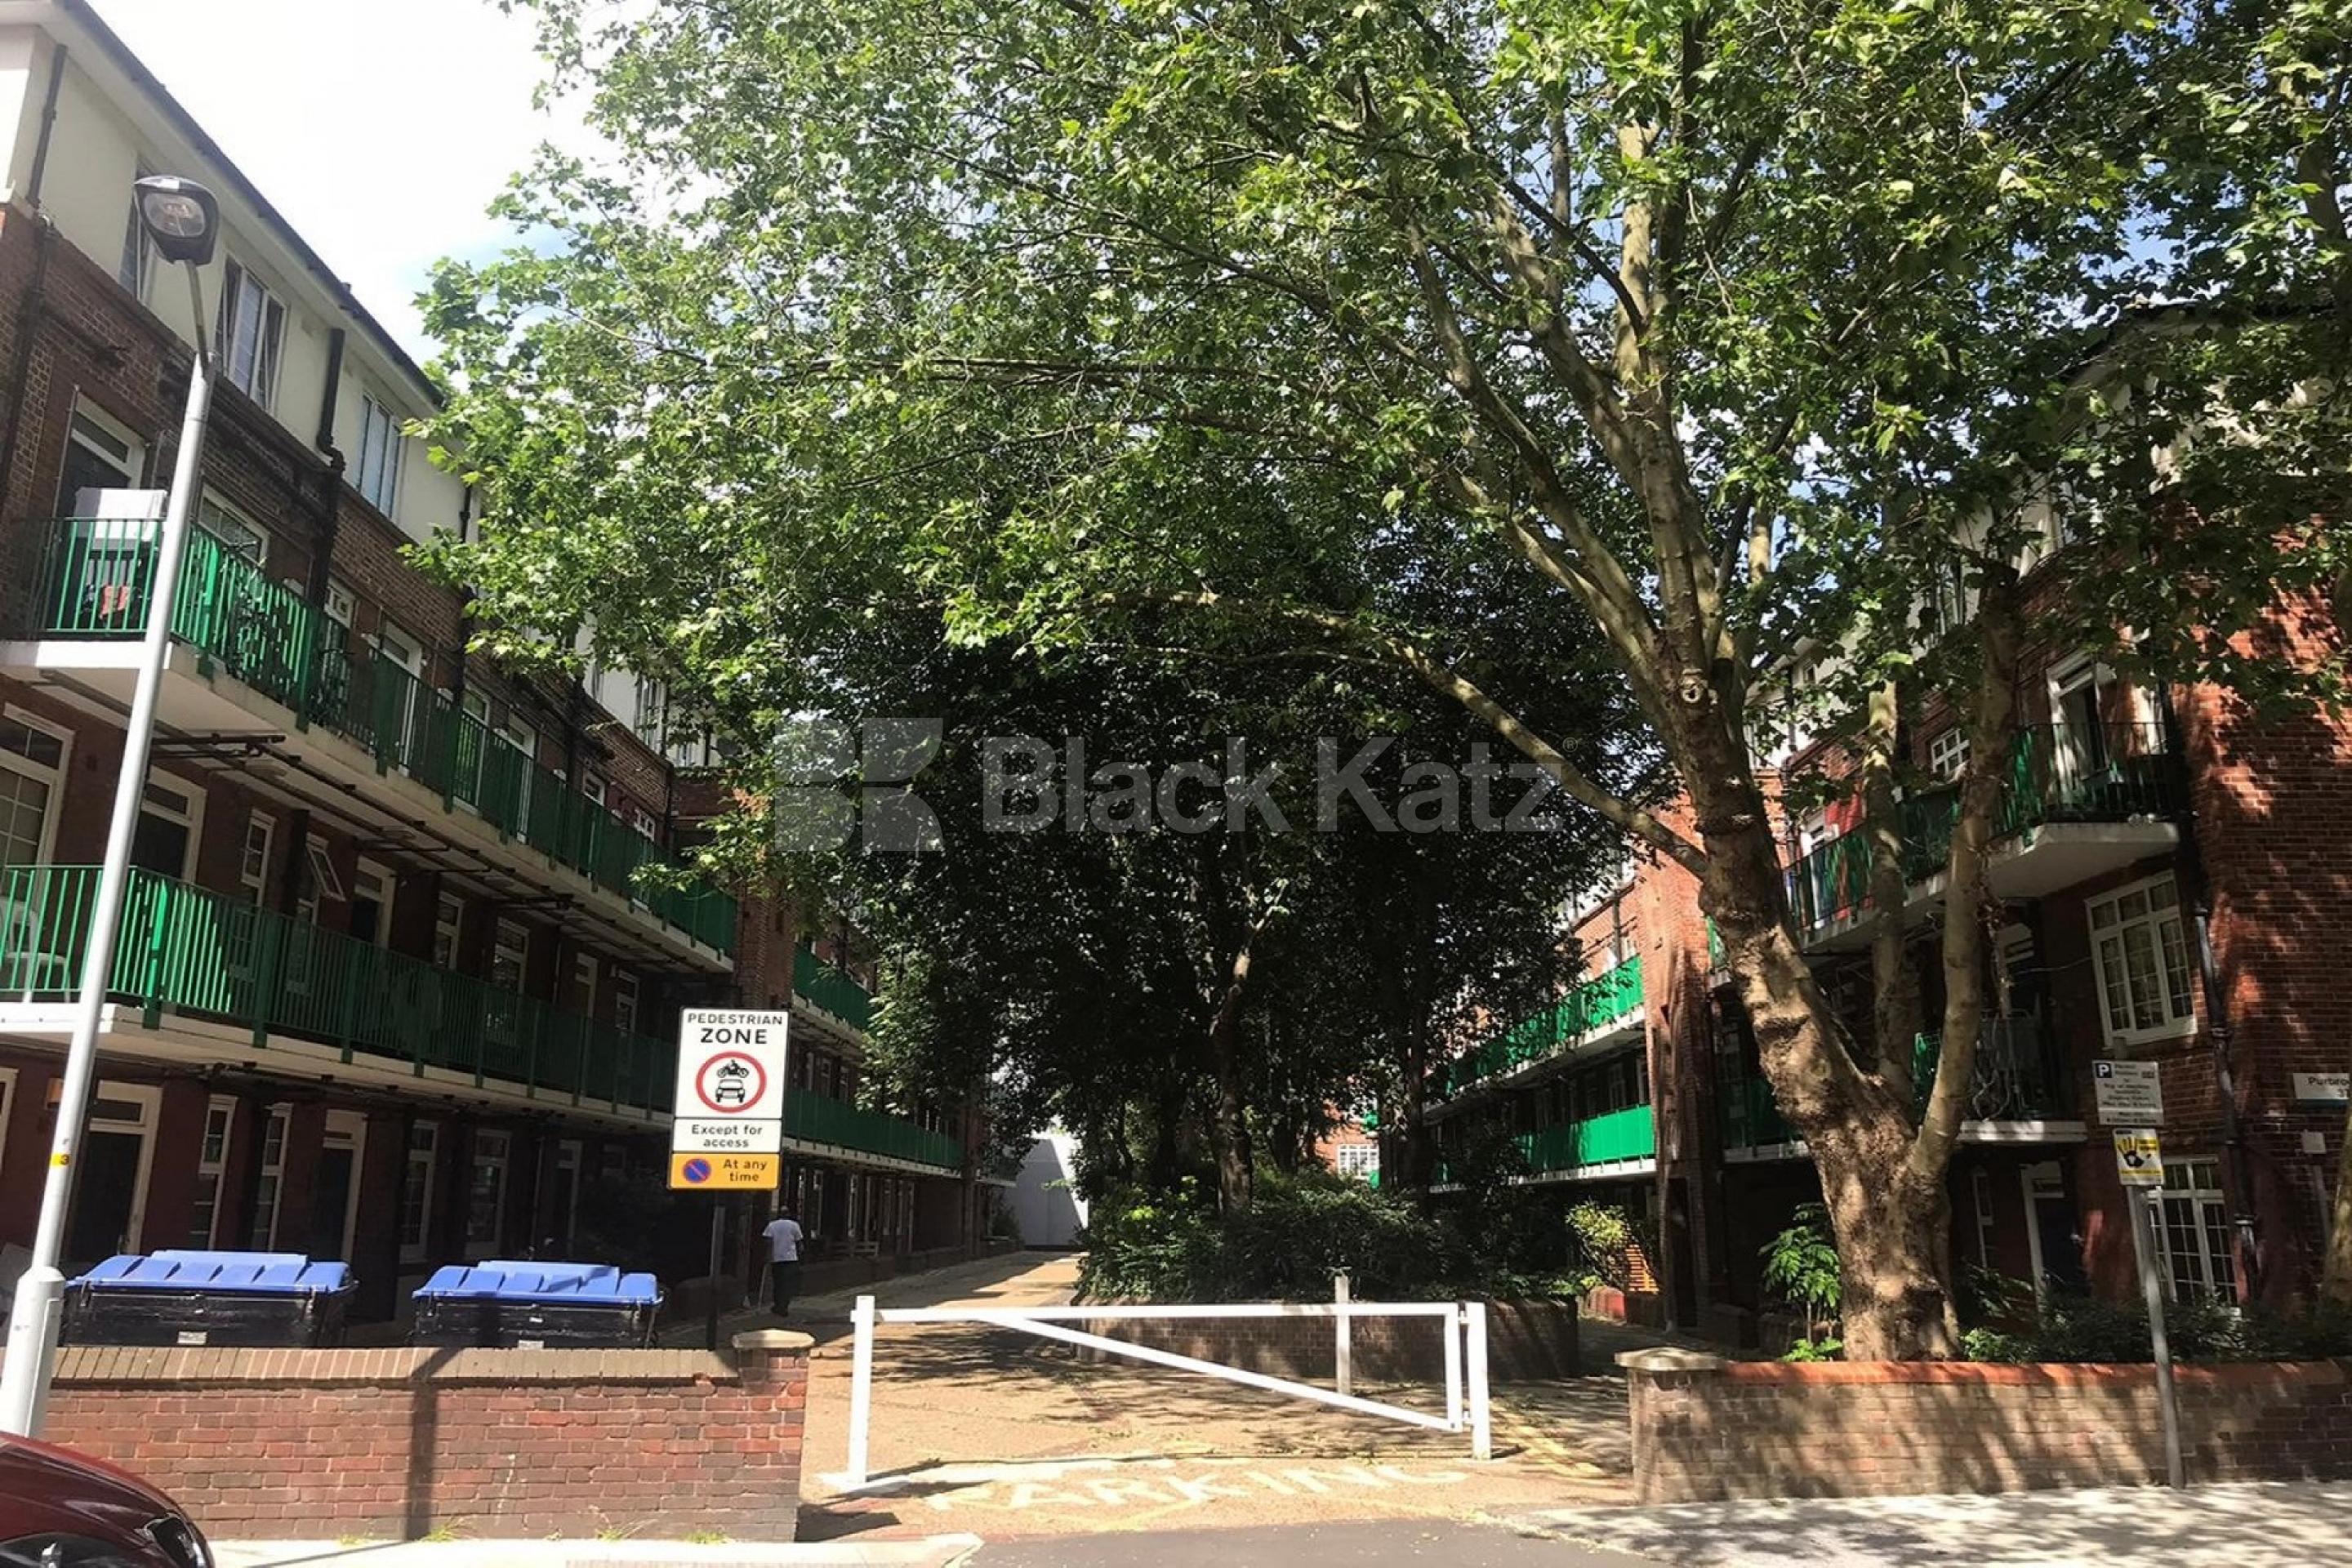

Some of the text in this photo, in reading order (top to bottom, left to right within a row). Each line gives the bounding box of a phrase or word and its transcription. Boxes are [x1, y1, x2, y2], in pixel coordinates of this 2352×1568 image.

[688, 1013, 782, 1025] PEDESTRIAN
[701, 1027, 768, 1044] ZONE
[2097, 1064, 2109, 1076] P
[692, 1124, 763, 1136] Except for
[703, 1139, 749, 1147] access
[723, 1159, 768, 1170] At any
[729, 1171, 760, 1181] time
[925, 1467, 1468, 1511] PARKING
